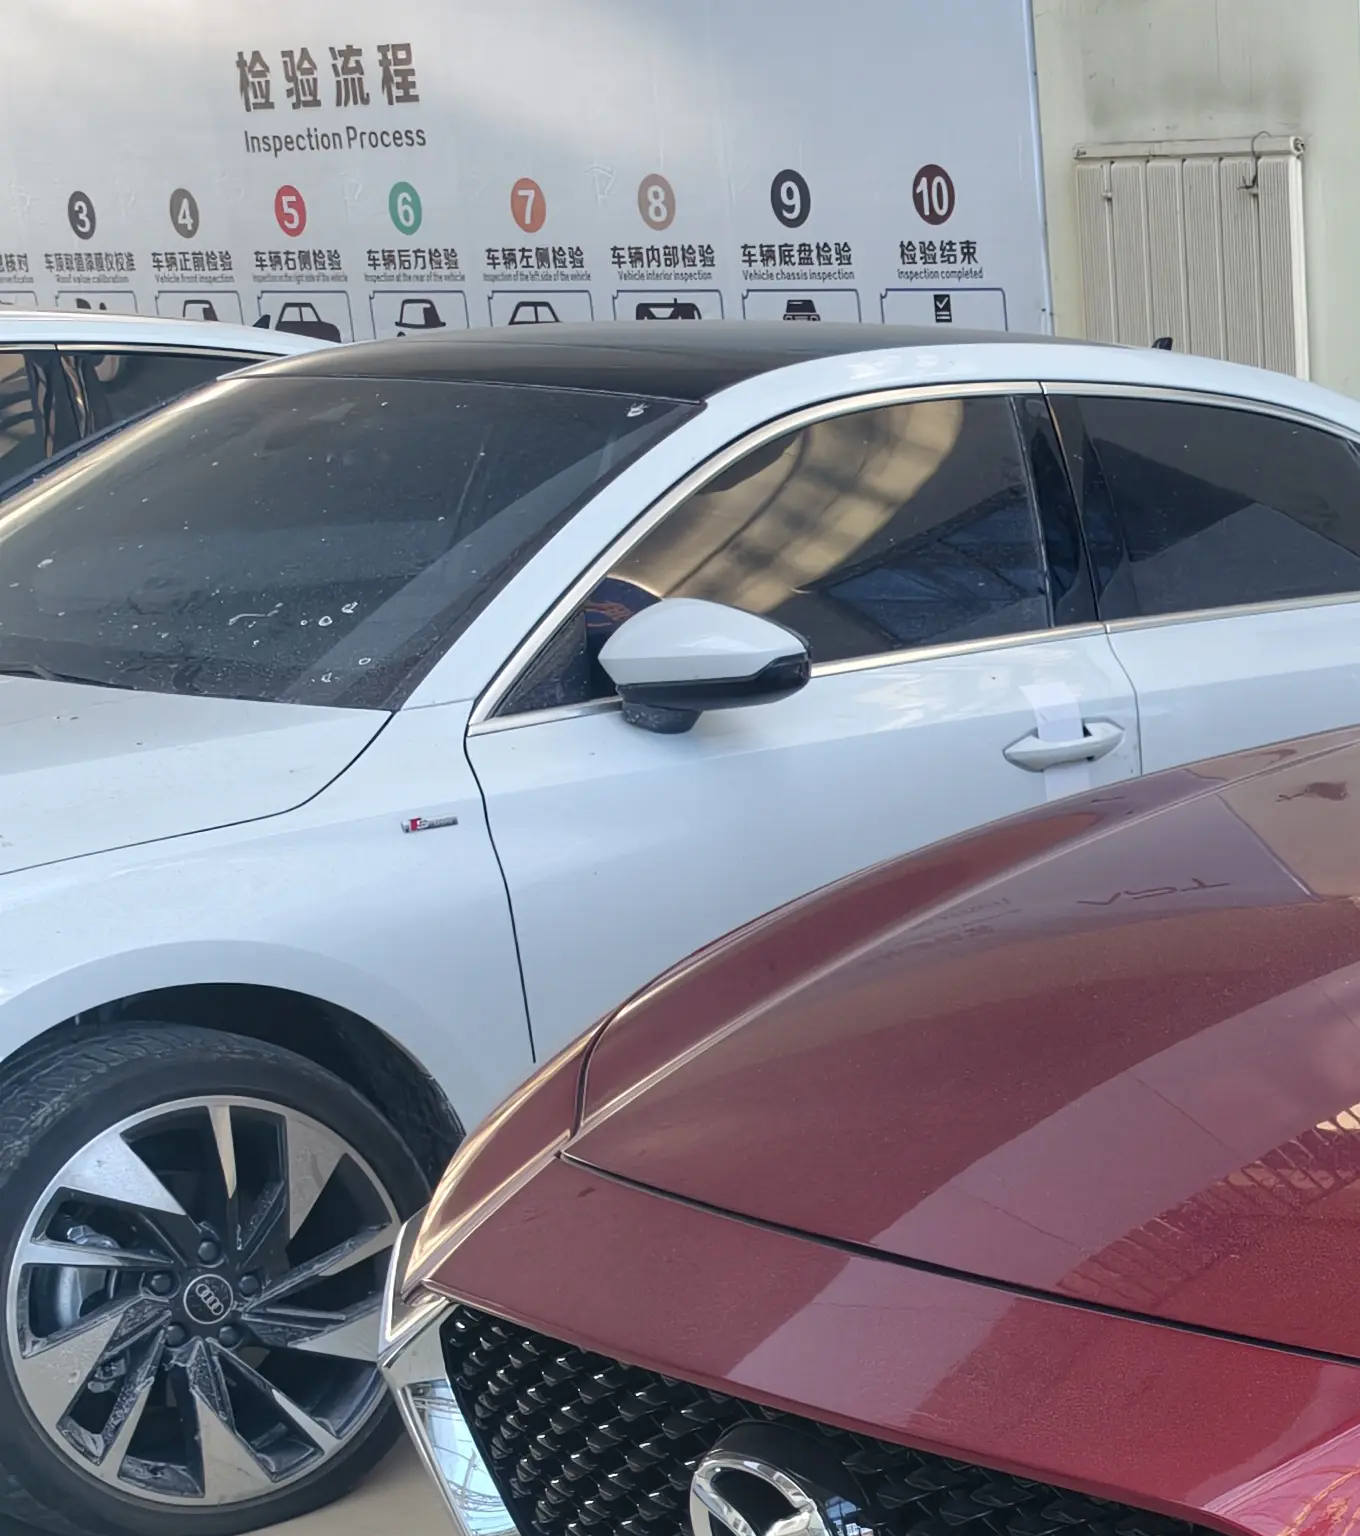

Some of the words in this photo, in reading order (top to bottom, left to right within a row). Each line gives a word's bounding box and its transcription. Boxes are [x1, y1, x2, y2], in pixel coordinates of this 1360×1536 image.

[236, 42, 420, 112] 检验流程
[244, 127, 343, 158] Inspection
[345, 125, 427, 150] Process
[397, 192, 414, 227] 6
[517, 189, 536, 225] 7
[647, 185, 668, 222] 8
[780, 180, 801, 220] 9
[915, 175, 950, 217] 10
[74, 200, 91, 233] 3
[177, 197, 194, 231] 4
[281, 195, 300, 229] 5
[151, 250, 233, 271] 车辆正前检验
[254, 249, 342, 271] 车辆右侧检验
[366, 248, 459, 270] 车辆后方检验
[485, 246, 585, 270] 车辆左侧检验
[610, 244, 716, 268] 车辆内部检验
[741, 242, 852, 267] 车辆底盘检验
[899, 240, 979, 265] 检验结束
[618, 270, 645, 281] Vehicle
[742, 269, 774, 280] Vehicle
[775, 268, 808, 281] chassis
[809, 268, 855, 282] inspection
[940, 267, 983, 282] completed
